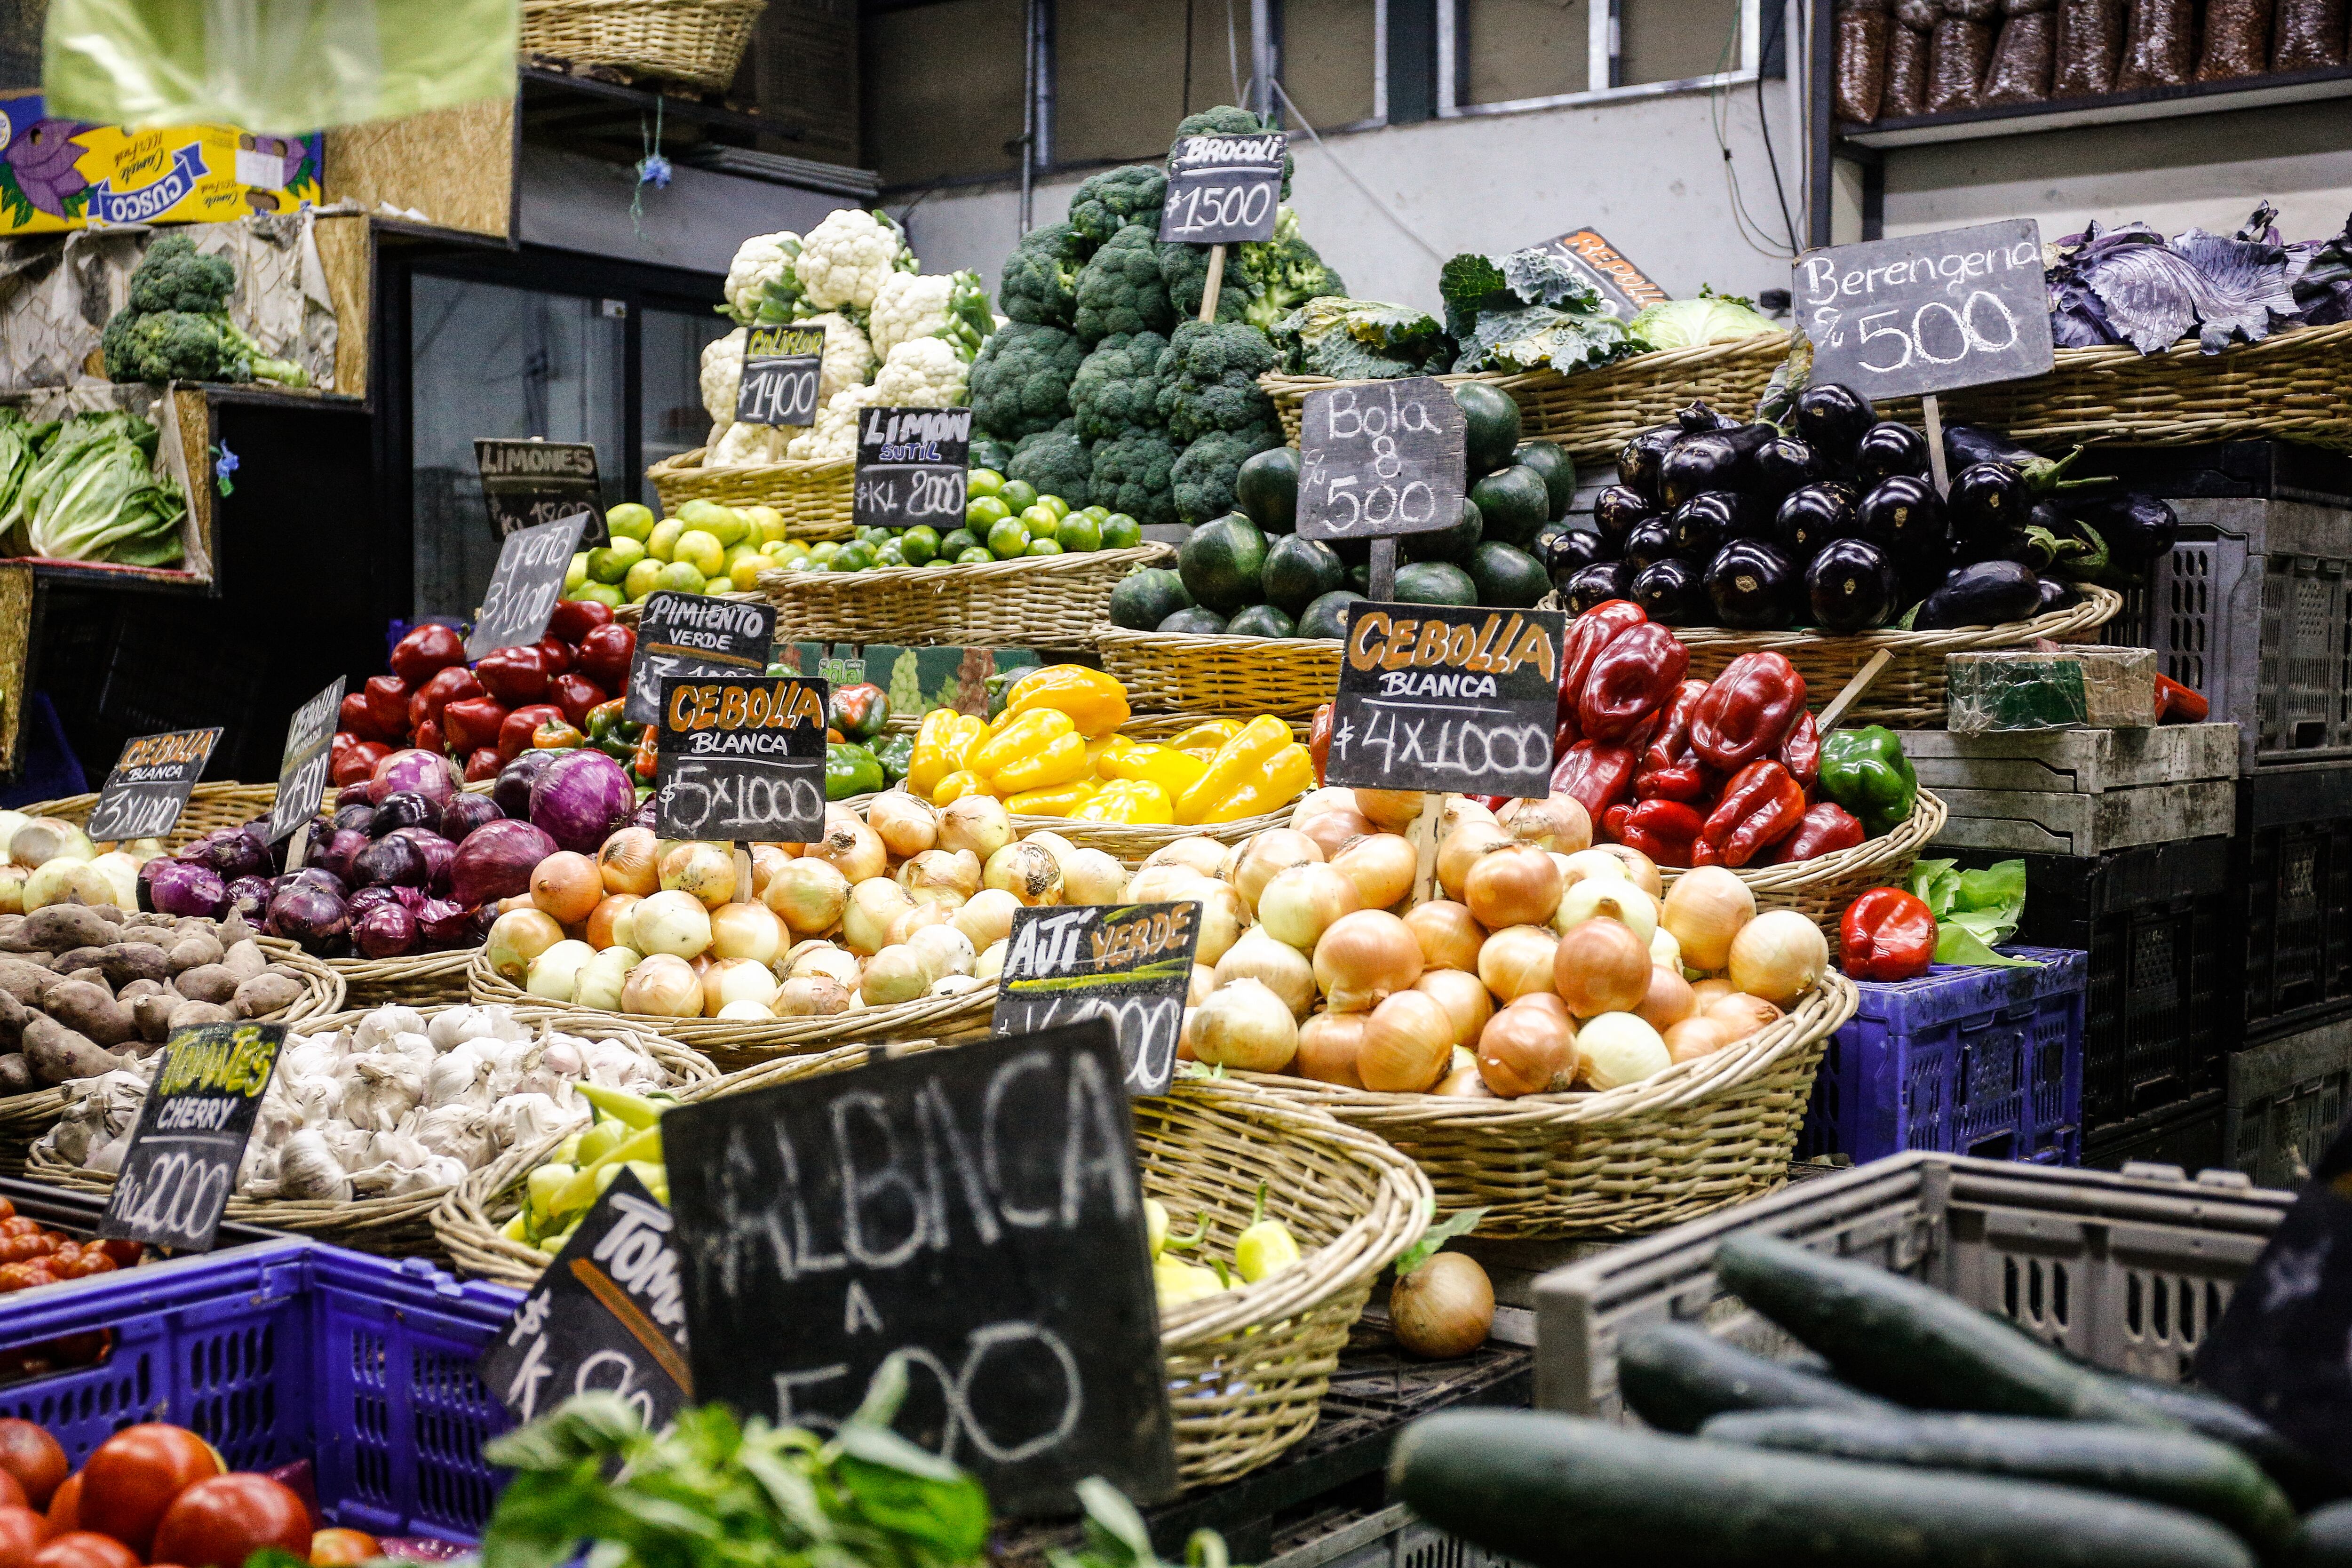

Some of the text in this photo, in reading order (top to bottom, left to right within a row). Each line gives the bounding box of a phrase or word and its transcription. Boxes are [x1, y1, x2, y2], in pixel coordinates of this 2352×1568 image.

[111, 174, 182, 221] CUSCO
[1859, 290, 2018, 373] 500
[1328, 384, 1442, 439] Bola
[480, 443, 595, 476] LIMONES
[1323, 475, 1435, 532] 500
[668, 628, 733, 650] VERDE
[1348, 612, 1555, 683] CEBOLLA
[668, 680, 824, 732] CEBOLLA
[1378, 671, 1497, 698] BLANCA
[119, 730, 214, 773] CEBOLLA
[688, 732, 788, 756] BLANCA
[127, 764, 183, 782] BLANCA
[1090, 902, 1196, 971] VERDE
[157, 1096, 240, 1131] CHERRY
[845, 1278, 885, 1334] A
